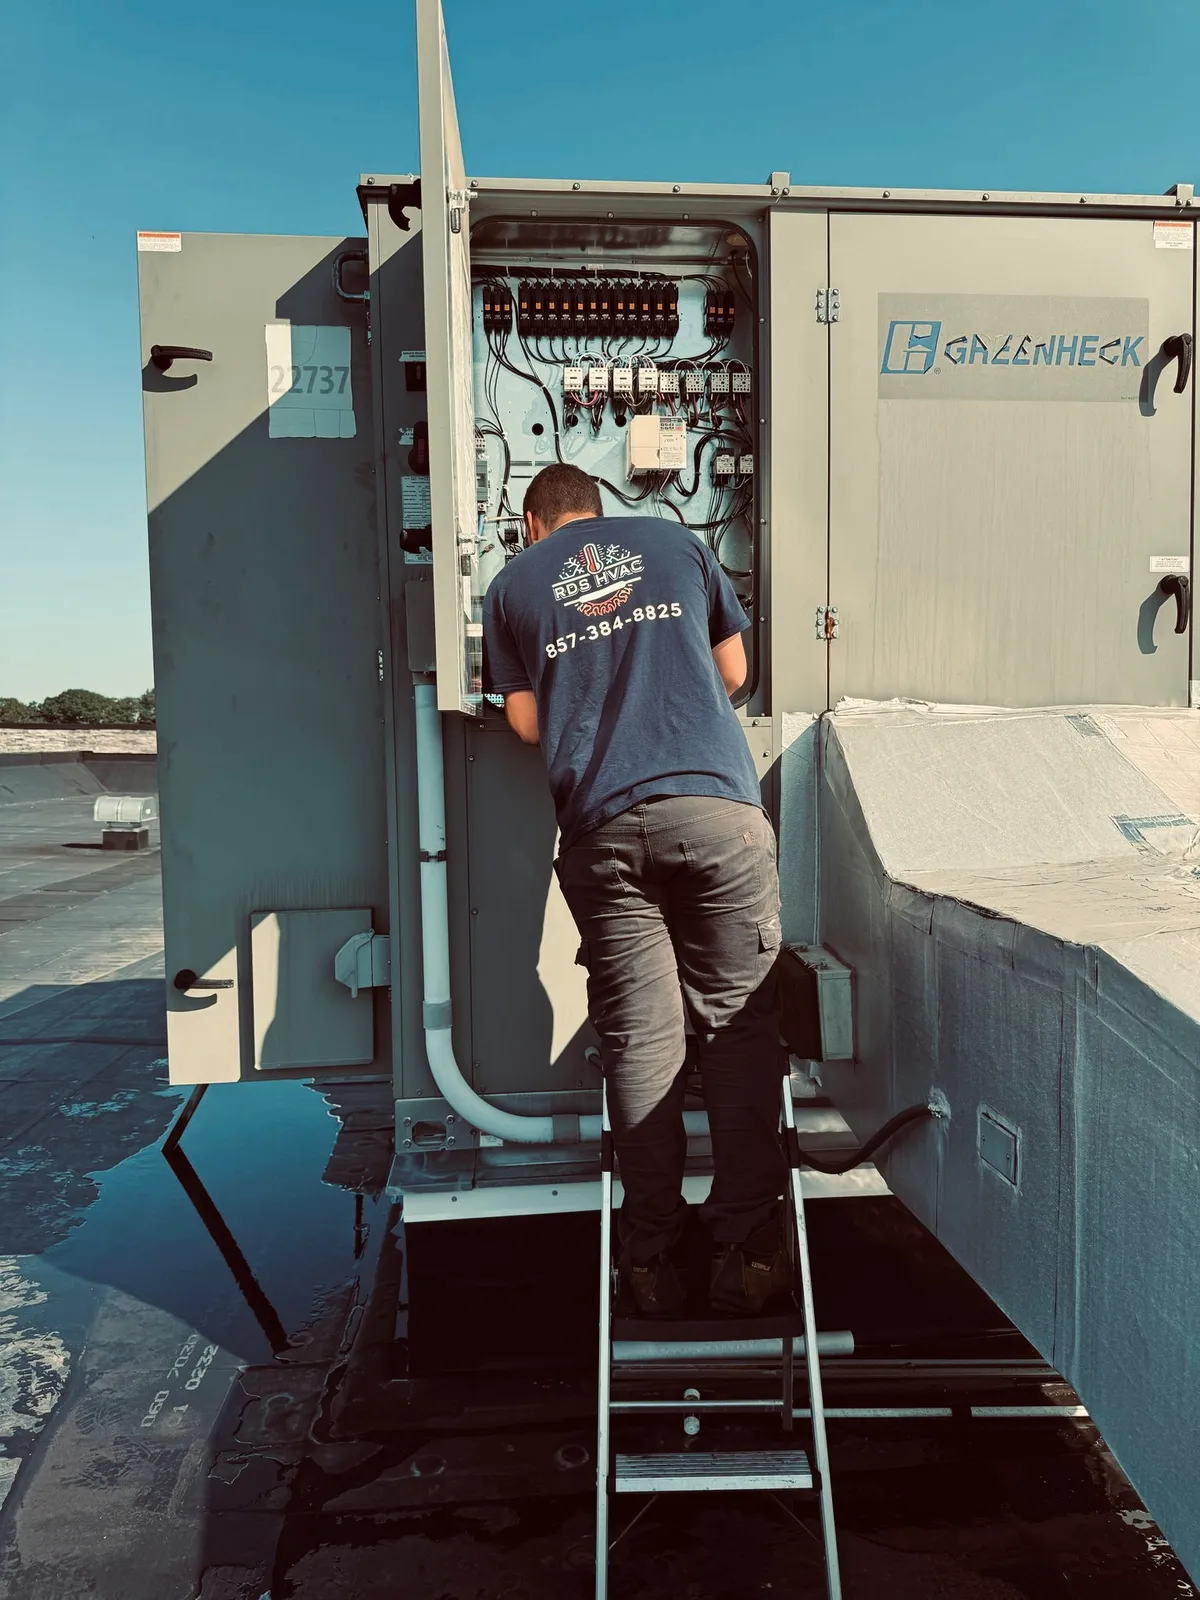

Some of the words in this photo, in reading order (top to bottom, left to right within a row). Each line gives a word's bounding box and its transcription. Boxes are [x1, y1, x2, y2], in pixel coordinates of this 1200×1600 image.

[270, 365, 350, 394] 22737
[552, 578, 592, 601] RDS
[594, 559, 645, 588] HVAC
[545, 602, 682, 659] 857-384-8825
[185, 1345, 219, 1390] 0232
